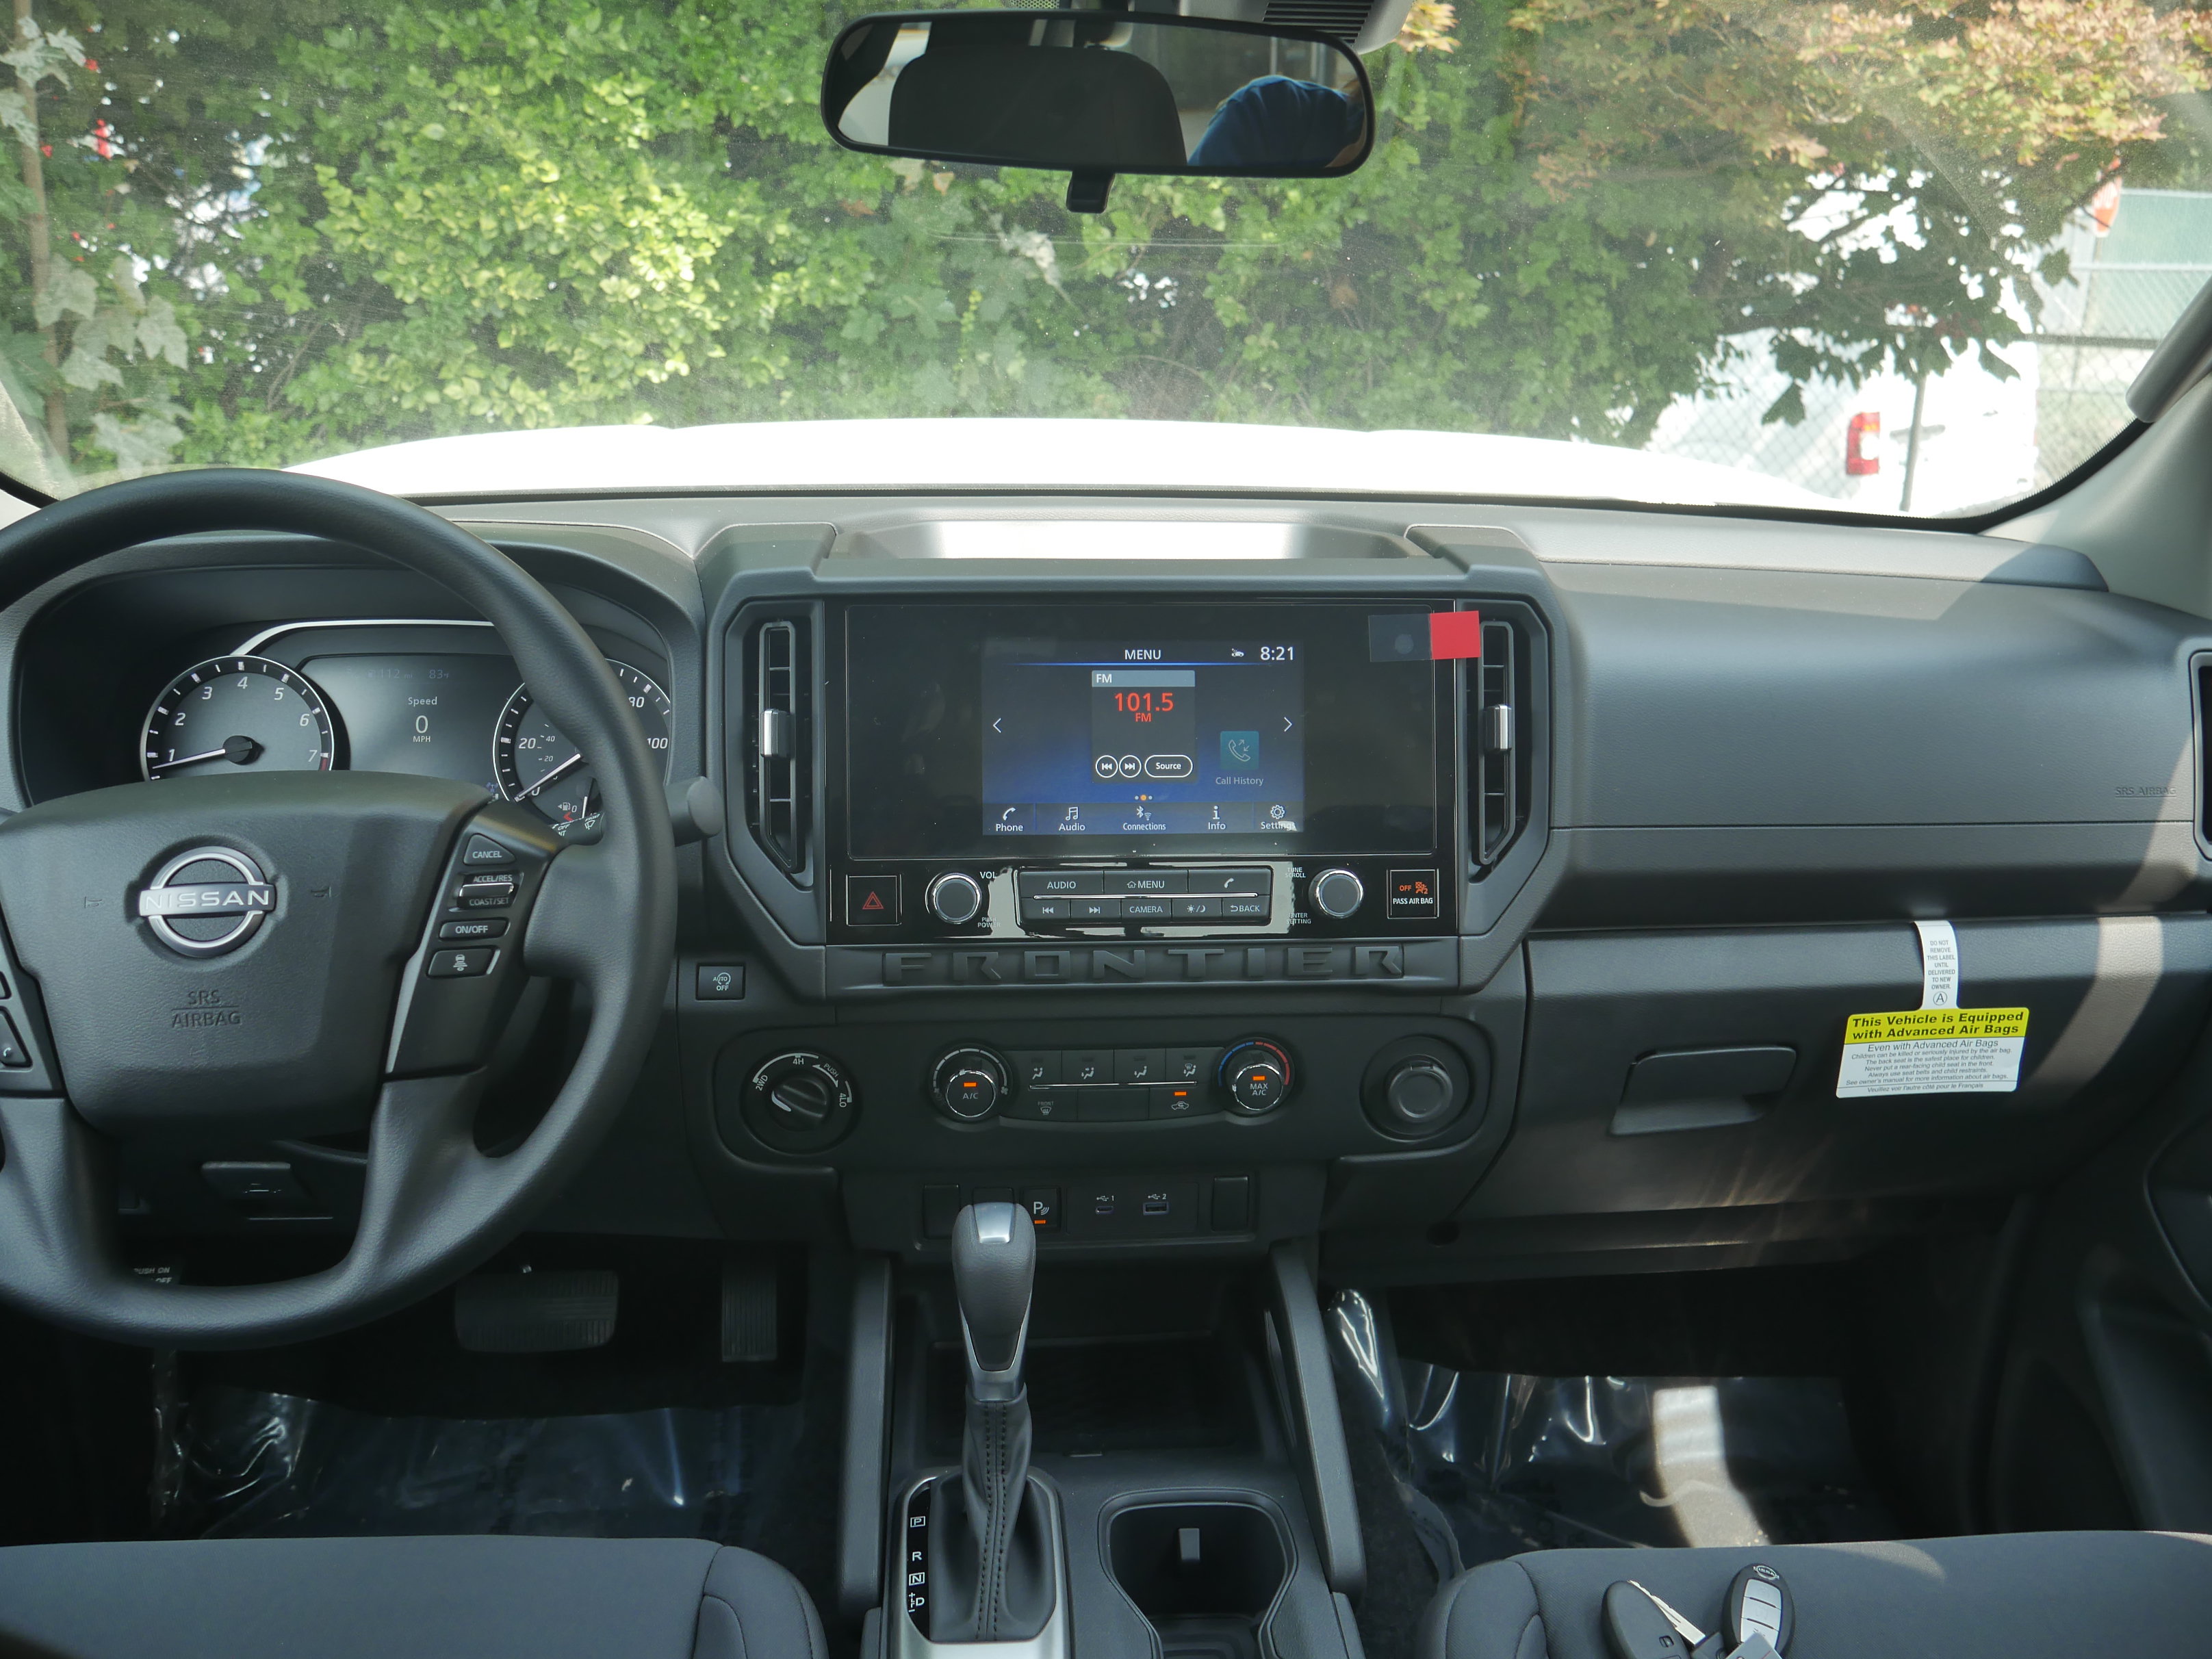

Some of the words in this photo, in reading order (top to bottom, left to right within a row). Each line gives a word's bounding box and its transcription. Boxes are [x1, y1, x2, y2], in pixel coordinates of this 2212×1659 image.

[1124, 649, 1161, 660] MENU
[1261, 646, 1294, 661] 8:21
[237, 676, 248, 689] 4
[1096, 673, 1112, 684] FM
[202, 686, 213, 699] 3
[274, 687, 285, 700] 5
[408, 696, 438, 707] Speed
[1115, 693, 1174, 712] 101.5
[175, 712, 186, 726] 2
[299, 713, 310, 726] 6
[1135, 713, 1151, 723] FM
[415, 715, 428, 734] 0
[519, 738, 536, 749] 20
[168, 749, 175, 762] 1
[308, 749, 318, 762] 7
[1155, 762, 1181, 770] Source
[1216, 776, 1231, 785] Call
[1233, 776, 1263, 786] History
[2115, 786, 2134, 795] SRS
[2139, 786, 2176, 795] AIRBAG
[571, 805, 577, 813] 0
[996, 823, 1023, 832] Phone
[1059, 823, 1085, 832] Audio
[1123, 822, 1166, 831] Connections
[1208, 821, 1226, 830] Info
[1261, 821, 1296, 832] Settings
[473, 874, 513, 883] ACCEL/RES
[1047, 881, 1077, 890] AUDIO
[1137, 880, 1165, 889] MENU
[146, 890, 269, 910] NISSAN
[469, 897, 509, 906] COAST/SET
[1129, 905, 1163, 914] CAMERA
[1239, 904, 1260, 913] BACK
[455, 925, 488, 934] ON/OFF
[883, 945, 1404, 982] FRONTIER
[188, 989, 220, 1005] SRS
[1936, 993, 1944, 1003] A
[172, 1010, 242, 1027] AIRBAG
[1853, 1018, 1881, 1027] This
[1887, 1014, 1938, 1025] Vehicle
[1942, 1014, 1954, 1023] is
[1959, 1012, 2024, 1024] Equipped
[1853, 1029, 1882, 1040] with
[1886, 1025, 1955, 1038] Advanced
[1959, 1025, 1980, 1034] Air
[1983, 1025, 2019, 1036] Bags
[1868, 1044, 1890, 1052] Even
[1893, 1042, 1911, 1051] with
[1913, 1040, 1957, 1049] Advanced
[1975, 1040, 1998, 1049] Bags
[823, 1063, 840, 1078] PUSH
[755, 1075, 769, 1091] 2WD
[1033, 1201, 1043, 1215] P
[912, 1552, 922, 1562] R
[916, 1597, 925, 1606] D
